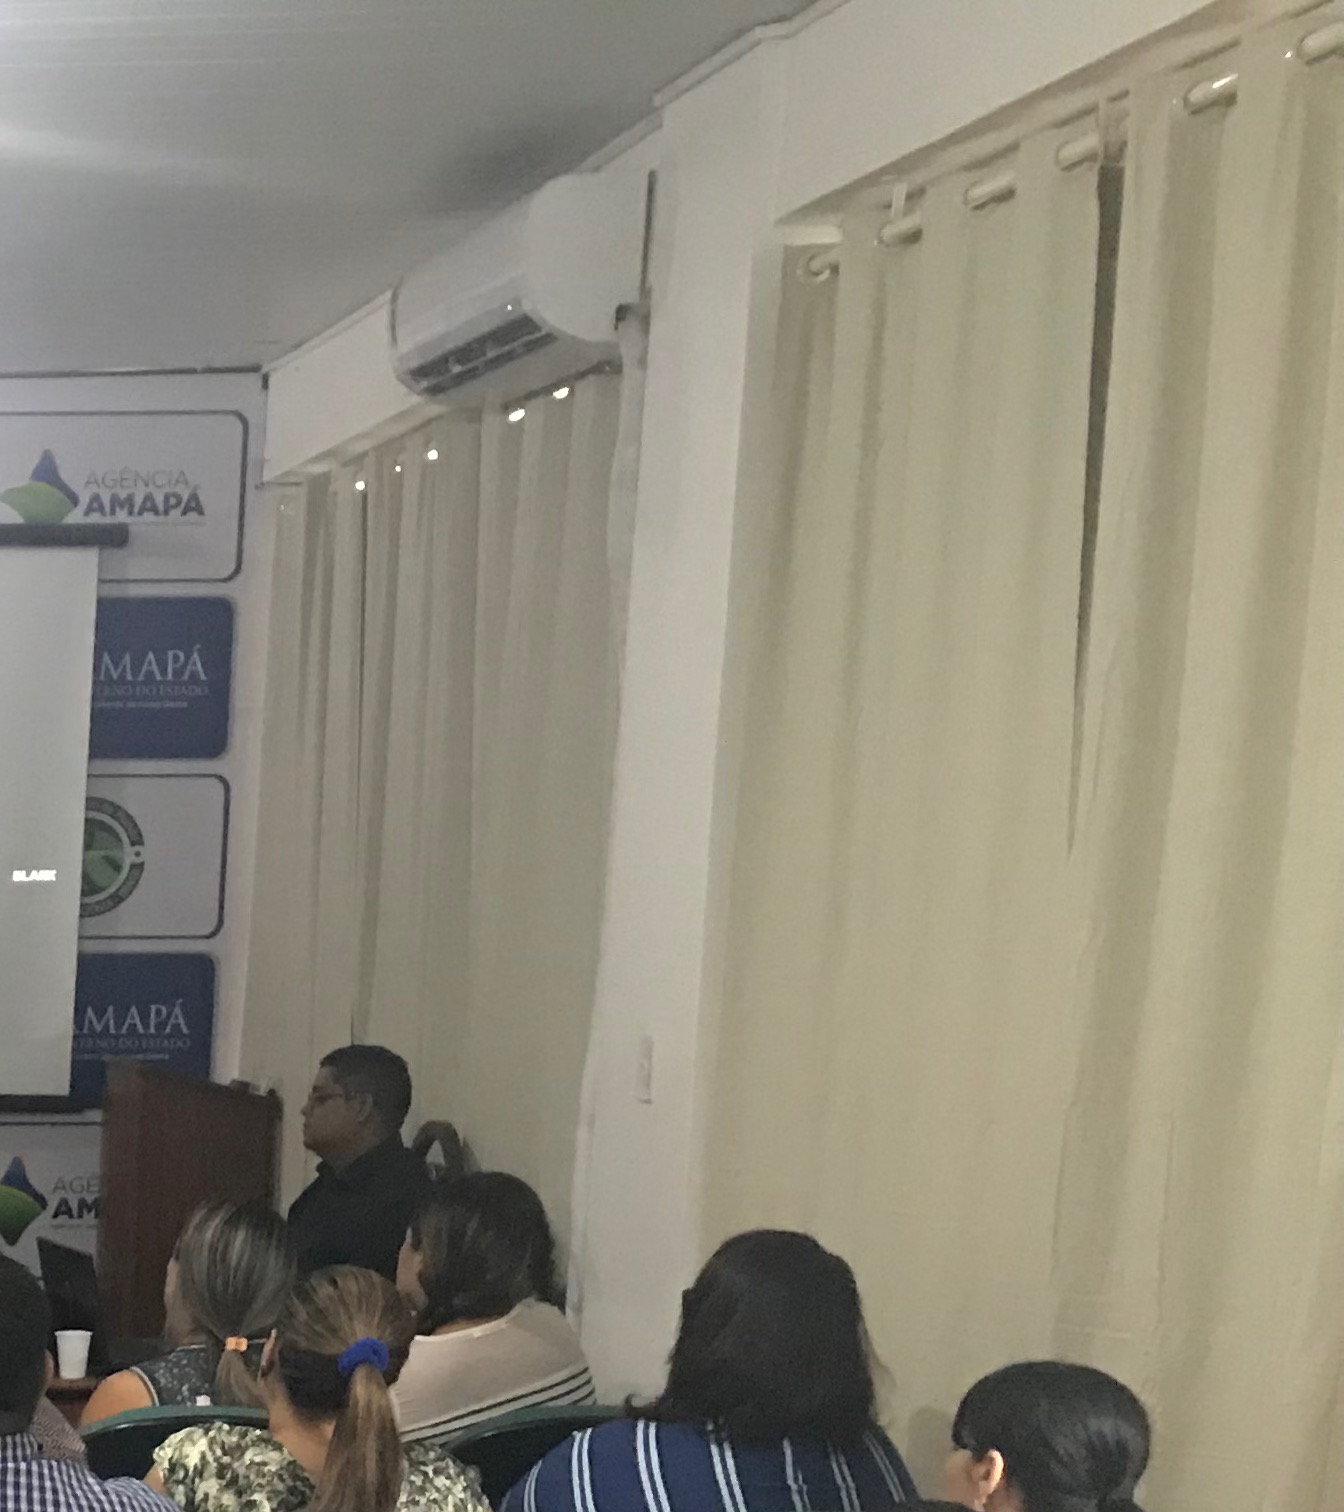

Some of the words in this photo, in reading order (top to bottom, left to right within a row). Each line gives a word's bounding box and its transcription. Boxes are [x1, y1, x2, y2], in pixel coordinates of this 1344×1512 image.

[84, 465, 190, 489] AGÊNCIA
[83, 484, 205, 517] AMAPÁ
[96, 644, 208, 681] MAPÁ
[75, 999, 190, 1034] MAPÁ
